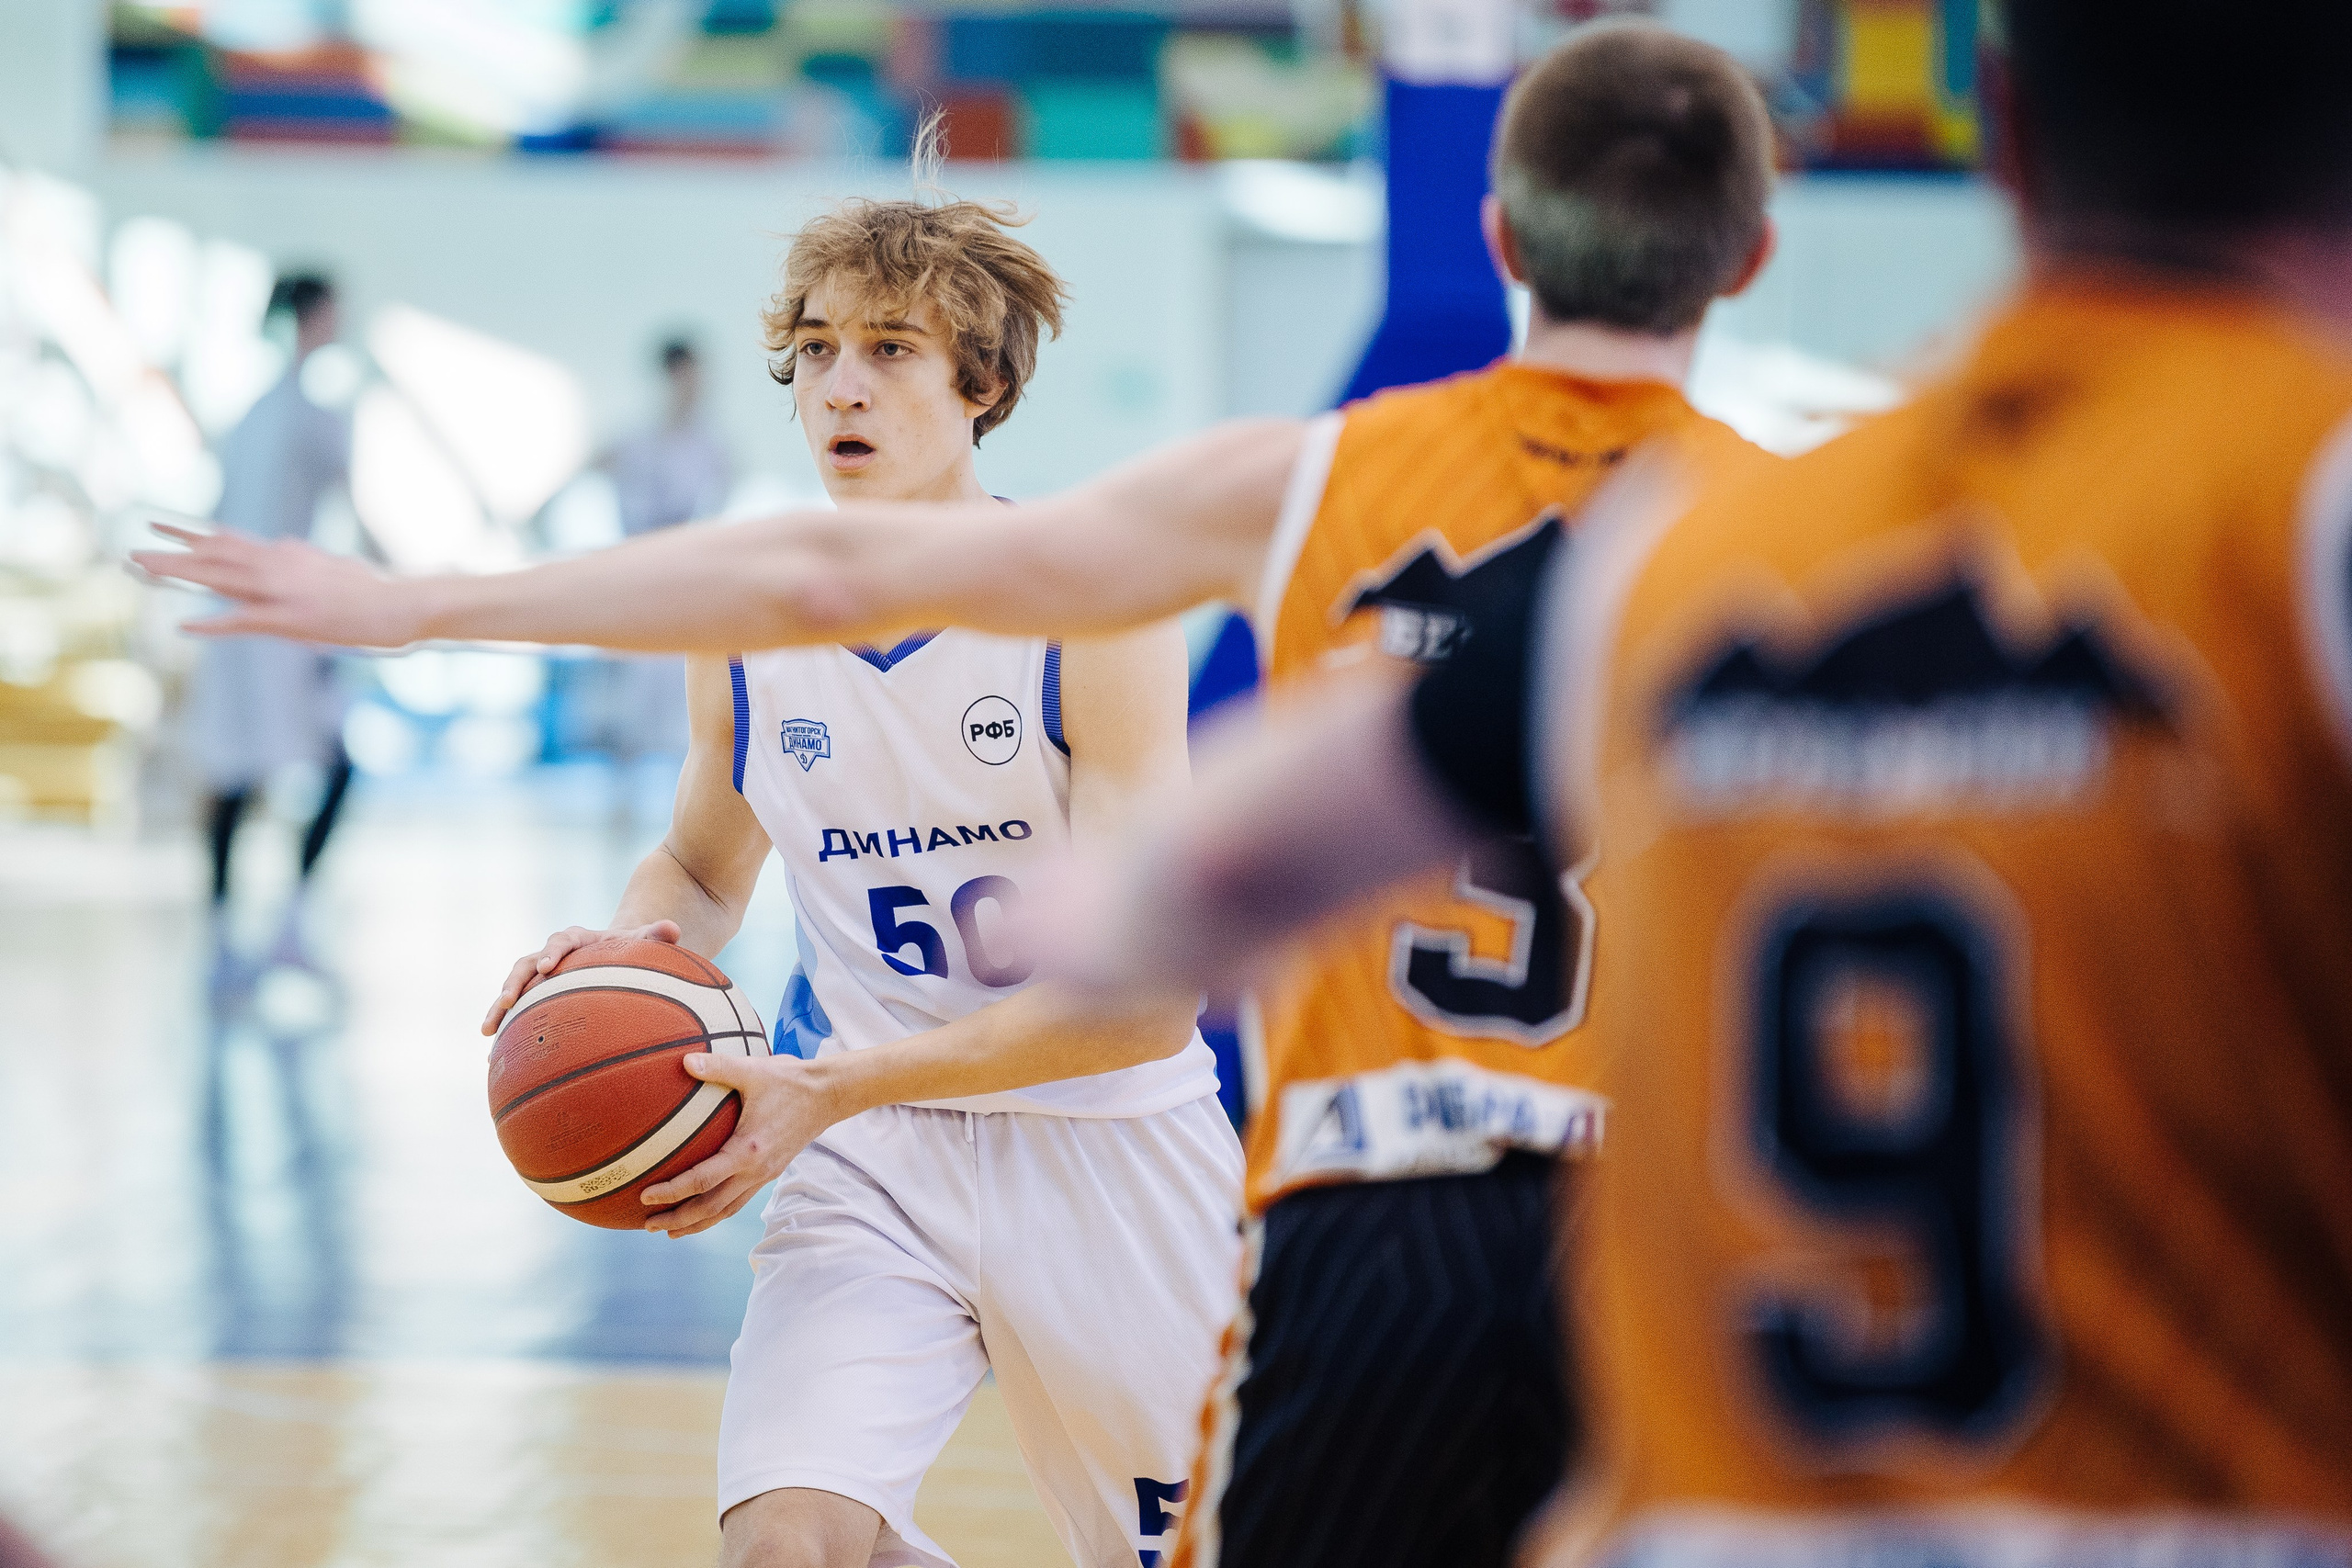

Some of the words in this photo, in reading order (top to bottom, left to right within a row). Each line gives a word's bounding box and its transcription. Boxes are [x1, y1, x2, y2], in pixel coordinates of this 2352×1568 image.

[789, 737, 822, 750] ДИНАМО
[969, 719, 1014, 741] РФБ
[819, 819, 1033, 862] ДИНАМО
[867, 875, 1036, 987] 50
[1736, 877, 2049, 1461] 9
